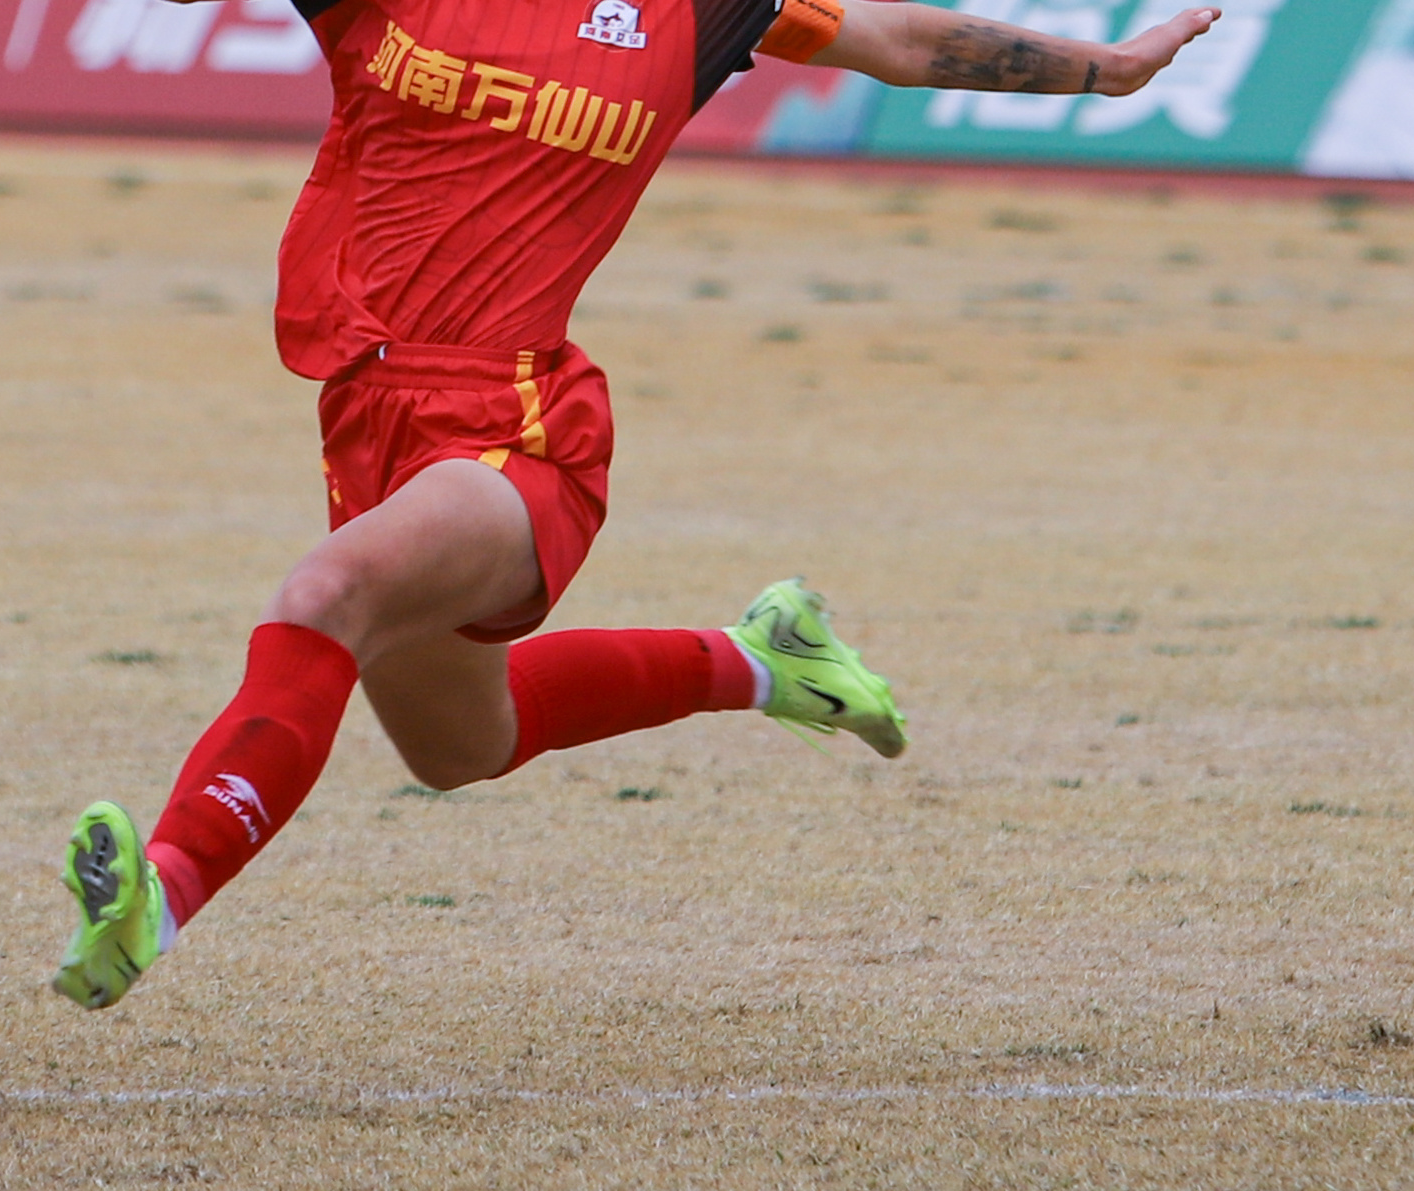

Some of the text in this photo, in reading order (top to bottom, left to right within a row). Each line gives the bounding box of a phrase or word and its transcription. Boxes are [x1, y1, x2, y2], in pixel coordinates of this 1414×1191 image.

[366, 20, 657, 166] 河南万仙山
